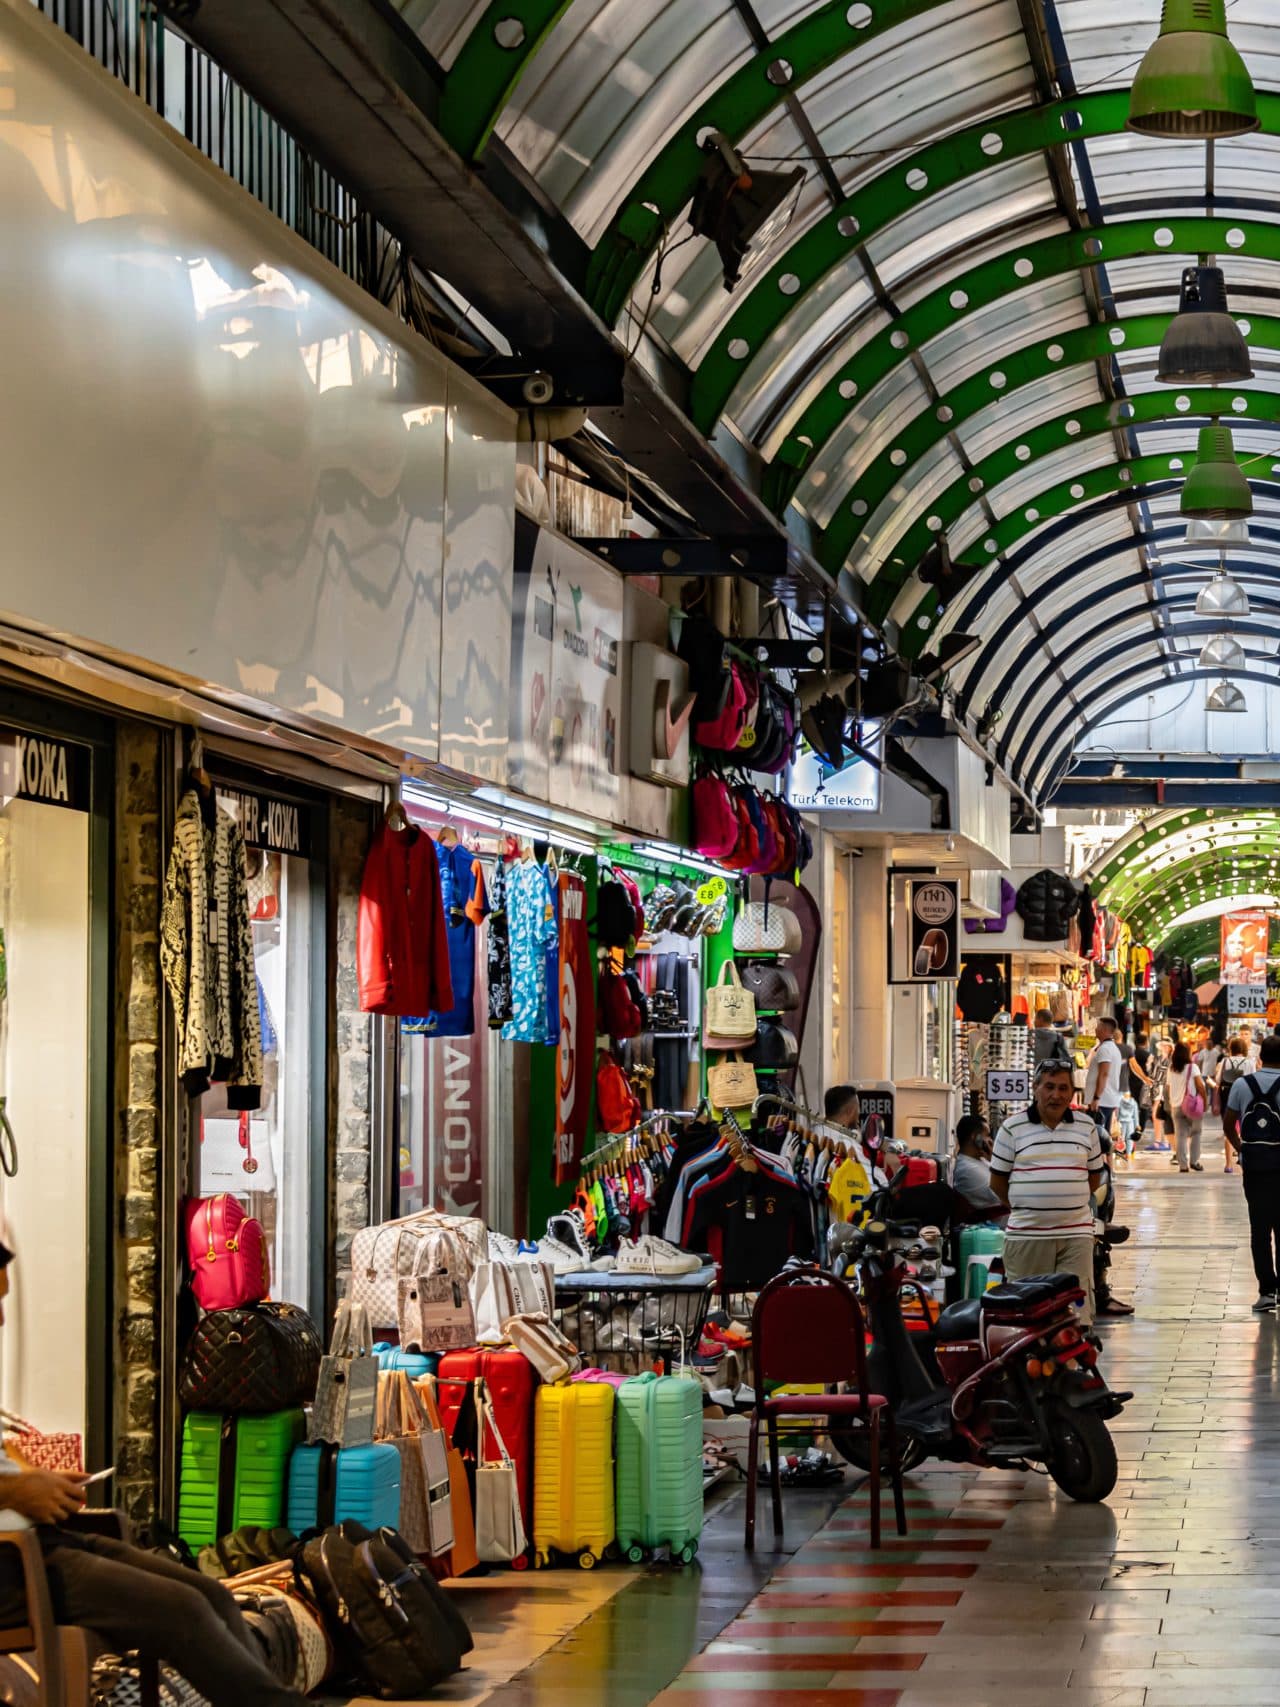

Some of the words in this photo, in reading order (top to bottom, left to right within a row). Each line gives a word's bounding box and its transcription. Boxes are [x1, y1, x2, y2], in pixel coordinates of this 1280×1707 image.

[791, 793, 817, 805] Türk
[822, 794, 874, 806] Telekom
[700, 890, 713, 899] £8
[991, 1077, 1001, 1095] $
[1004, 1079, 1025, 1094] 55
